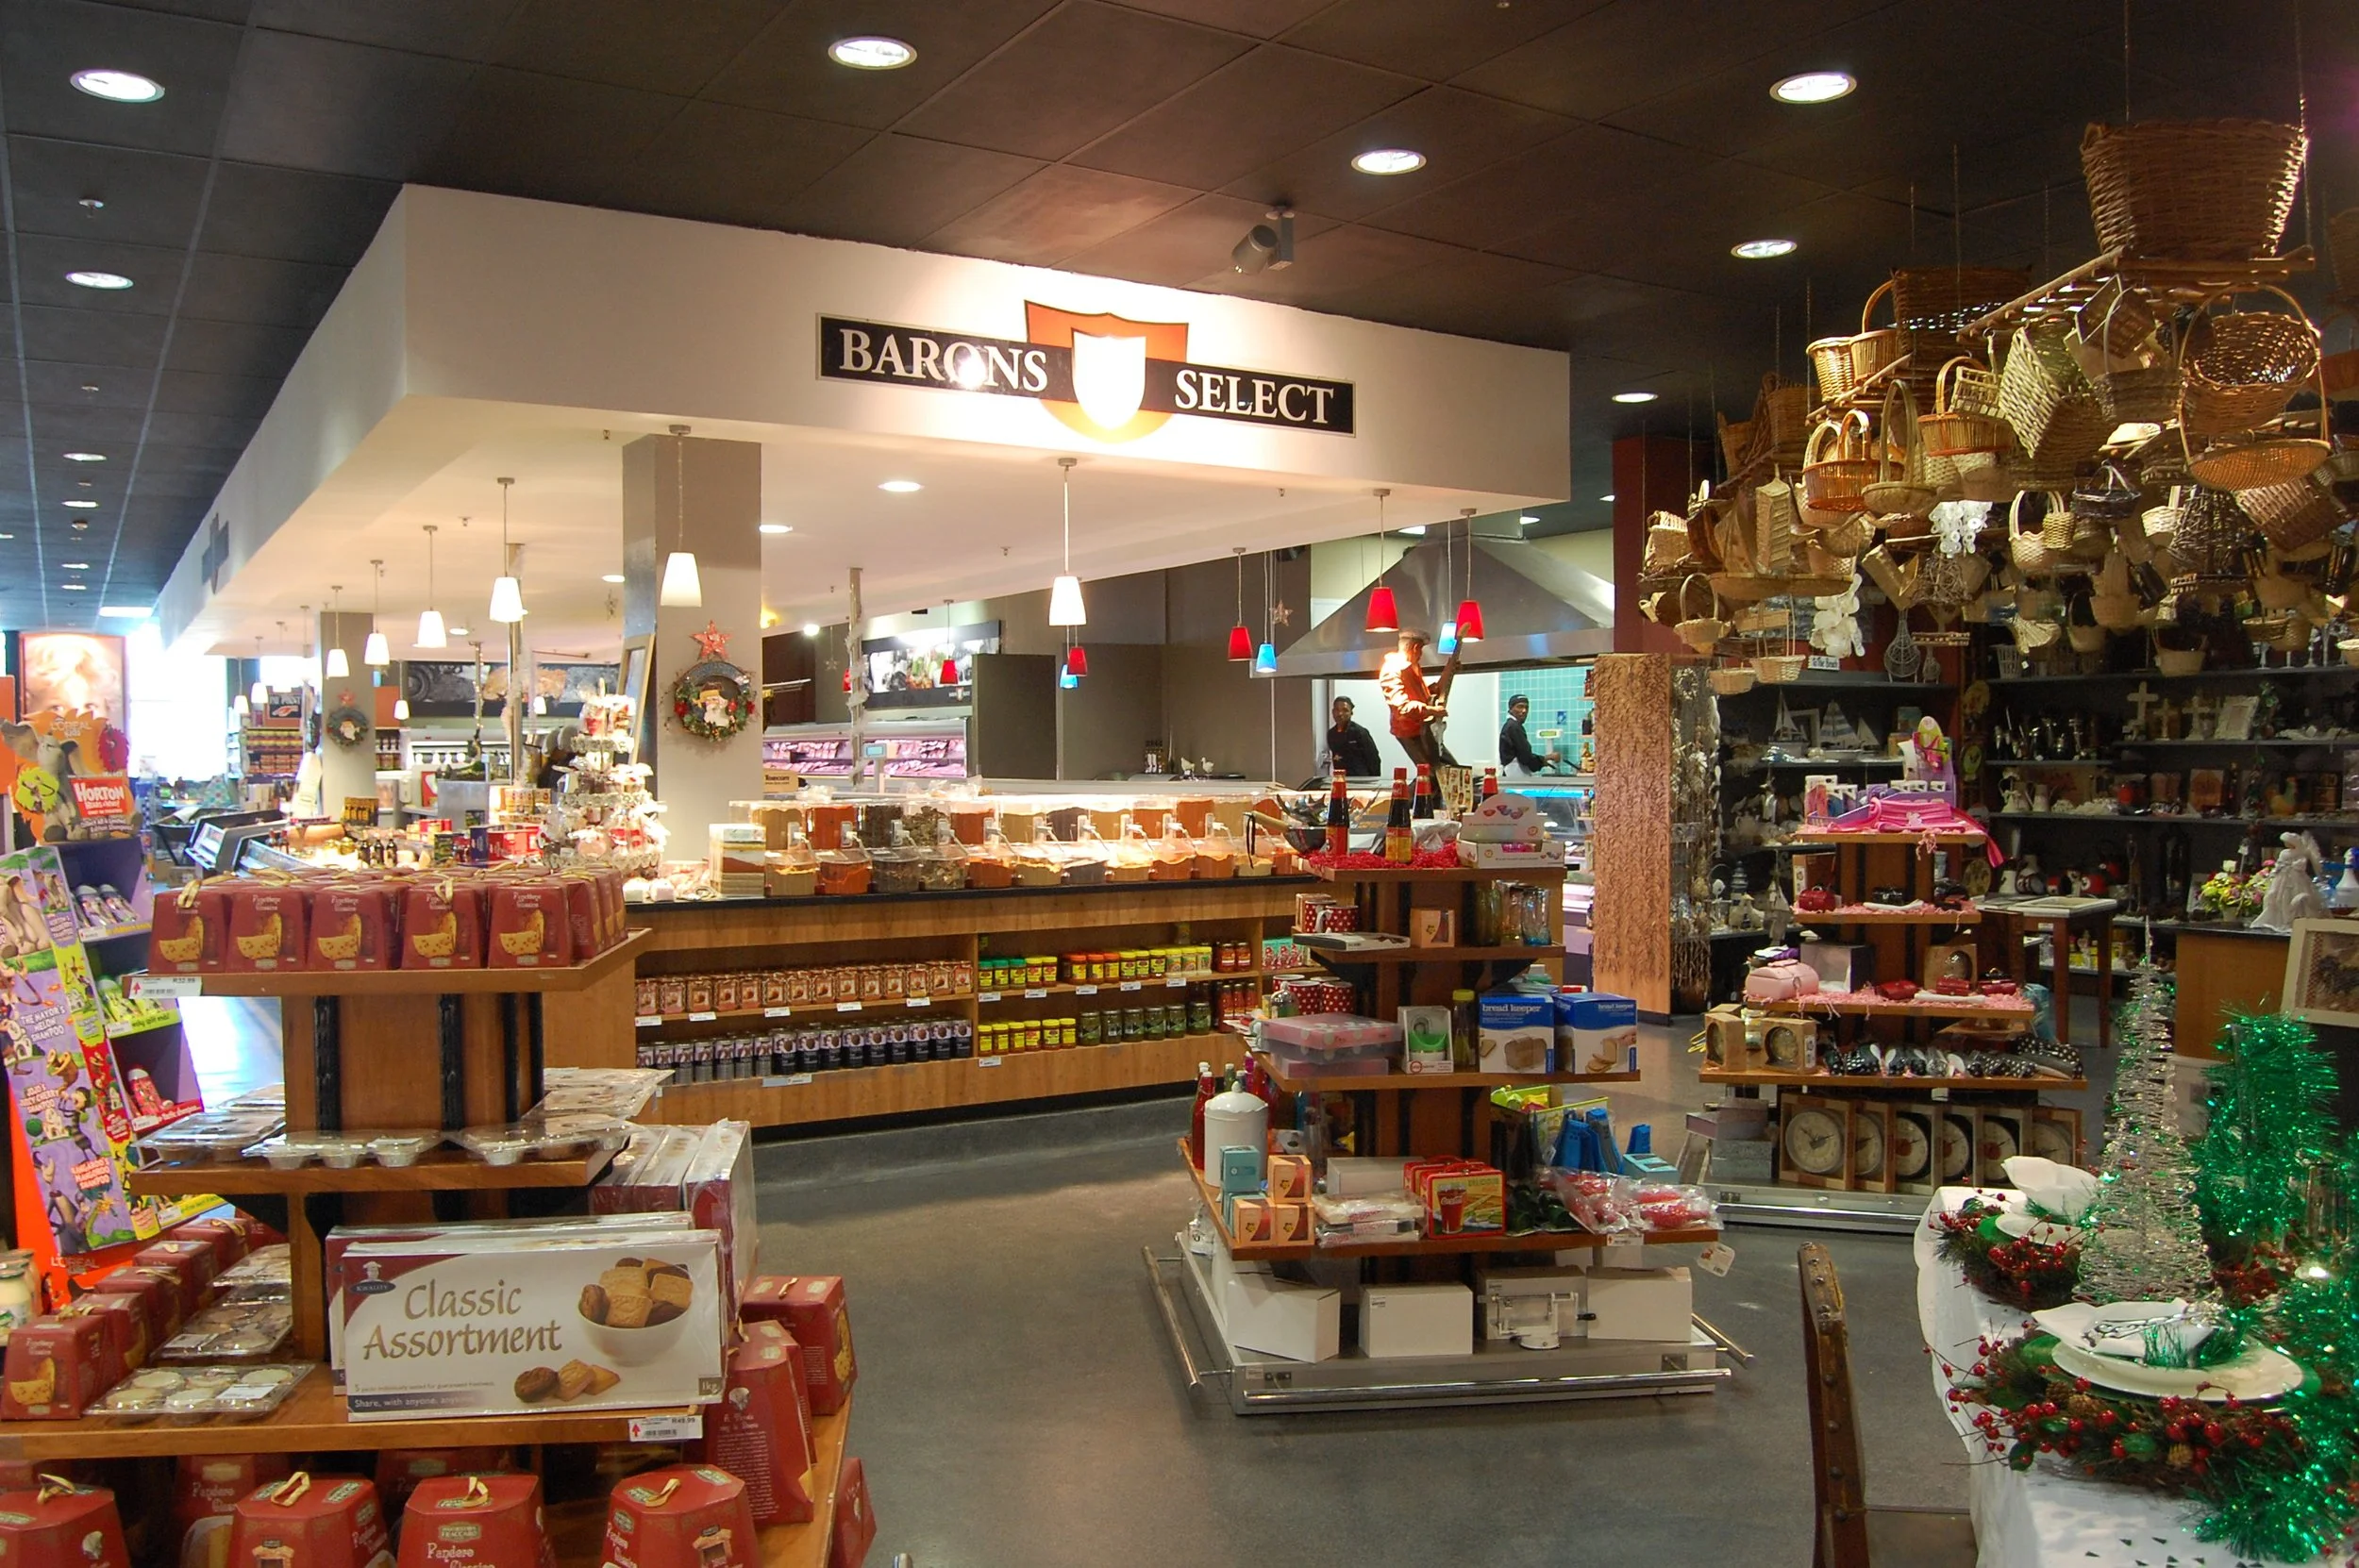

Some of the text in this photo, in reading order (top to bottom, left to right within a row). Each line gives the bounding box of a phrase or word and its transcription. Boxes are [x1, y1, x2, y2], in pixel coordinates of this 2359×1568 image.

[839, 327, 1334, 425] BARONS SELECT
[74, 782, 125, 802] HORTON
[1481, 1002, 1542, 1014] bread keeper
[1598, 1002, 1614, 1010] bread
[20, 1005, 66, 1026] THE MAYOR'S
[31, 1025, 64, 1042] SHAMPOO
[404, 1278, 523, 1321] Classic
[362, 1319, 563, 1360] Assortment
[702, 1380, 718, 1393] 1kg
[383, 1397, 403, 1407] with
